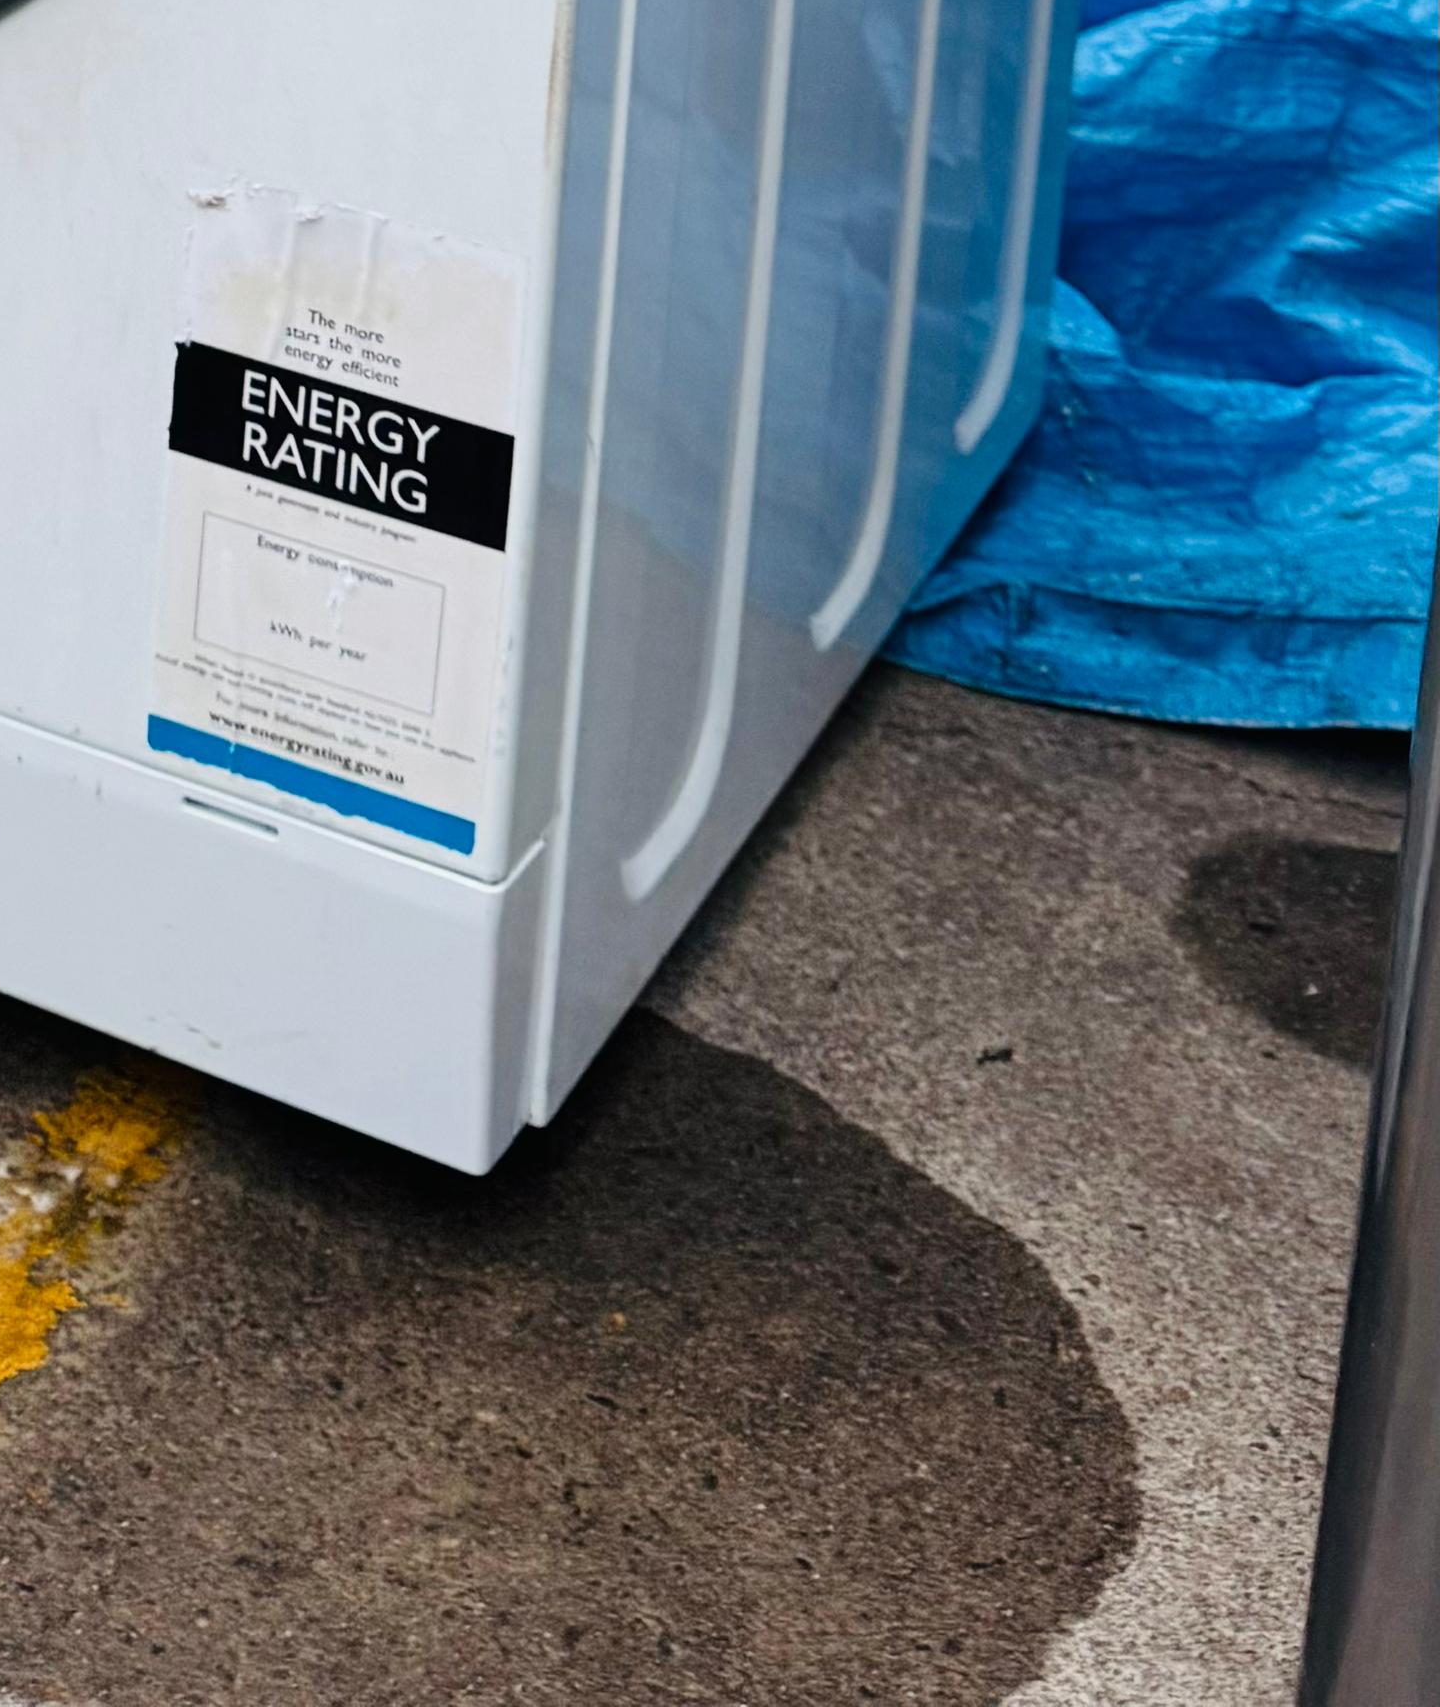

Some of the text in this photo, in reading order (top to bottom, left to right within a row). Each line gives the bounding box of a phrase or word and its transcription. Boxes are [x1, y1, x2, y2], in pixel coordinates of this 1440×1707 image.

[285, 325, 402, 369] stars the more
[308, 309, 385, 344] The more
[285, 344, 400, 387] energy efficient
[242, 369, 440, 464] ENERGY
[242, 420, 428, 514] RATING
[257, 533, 301, 561] Energy
